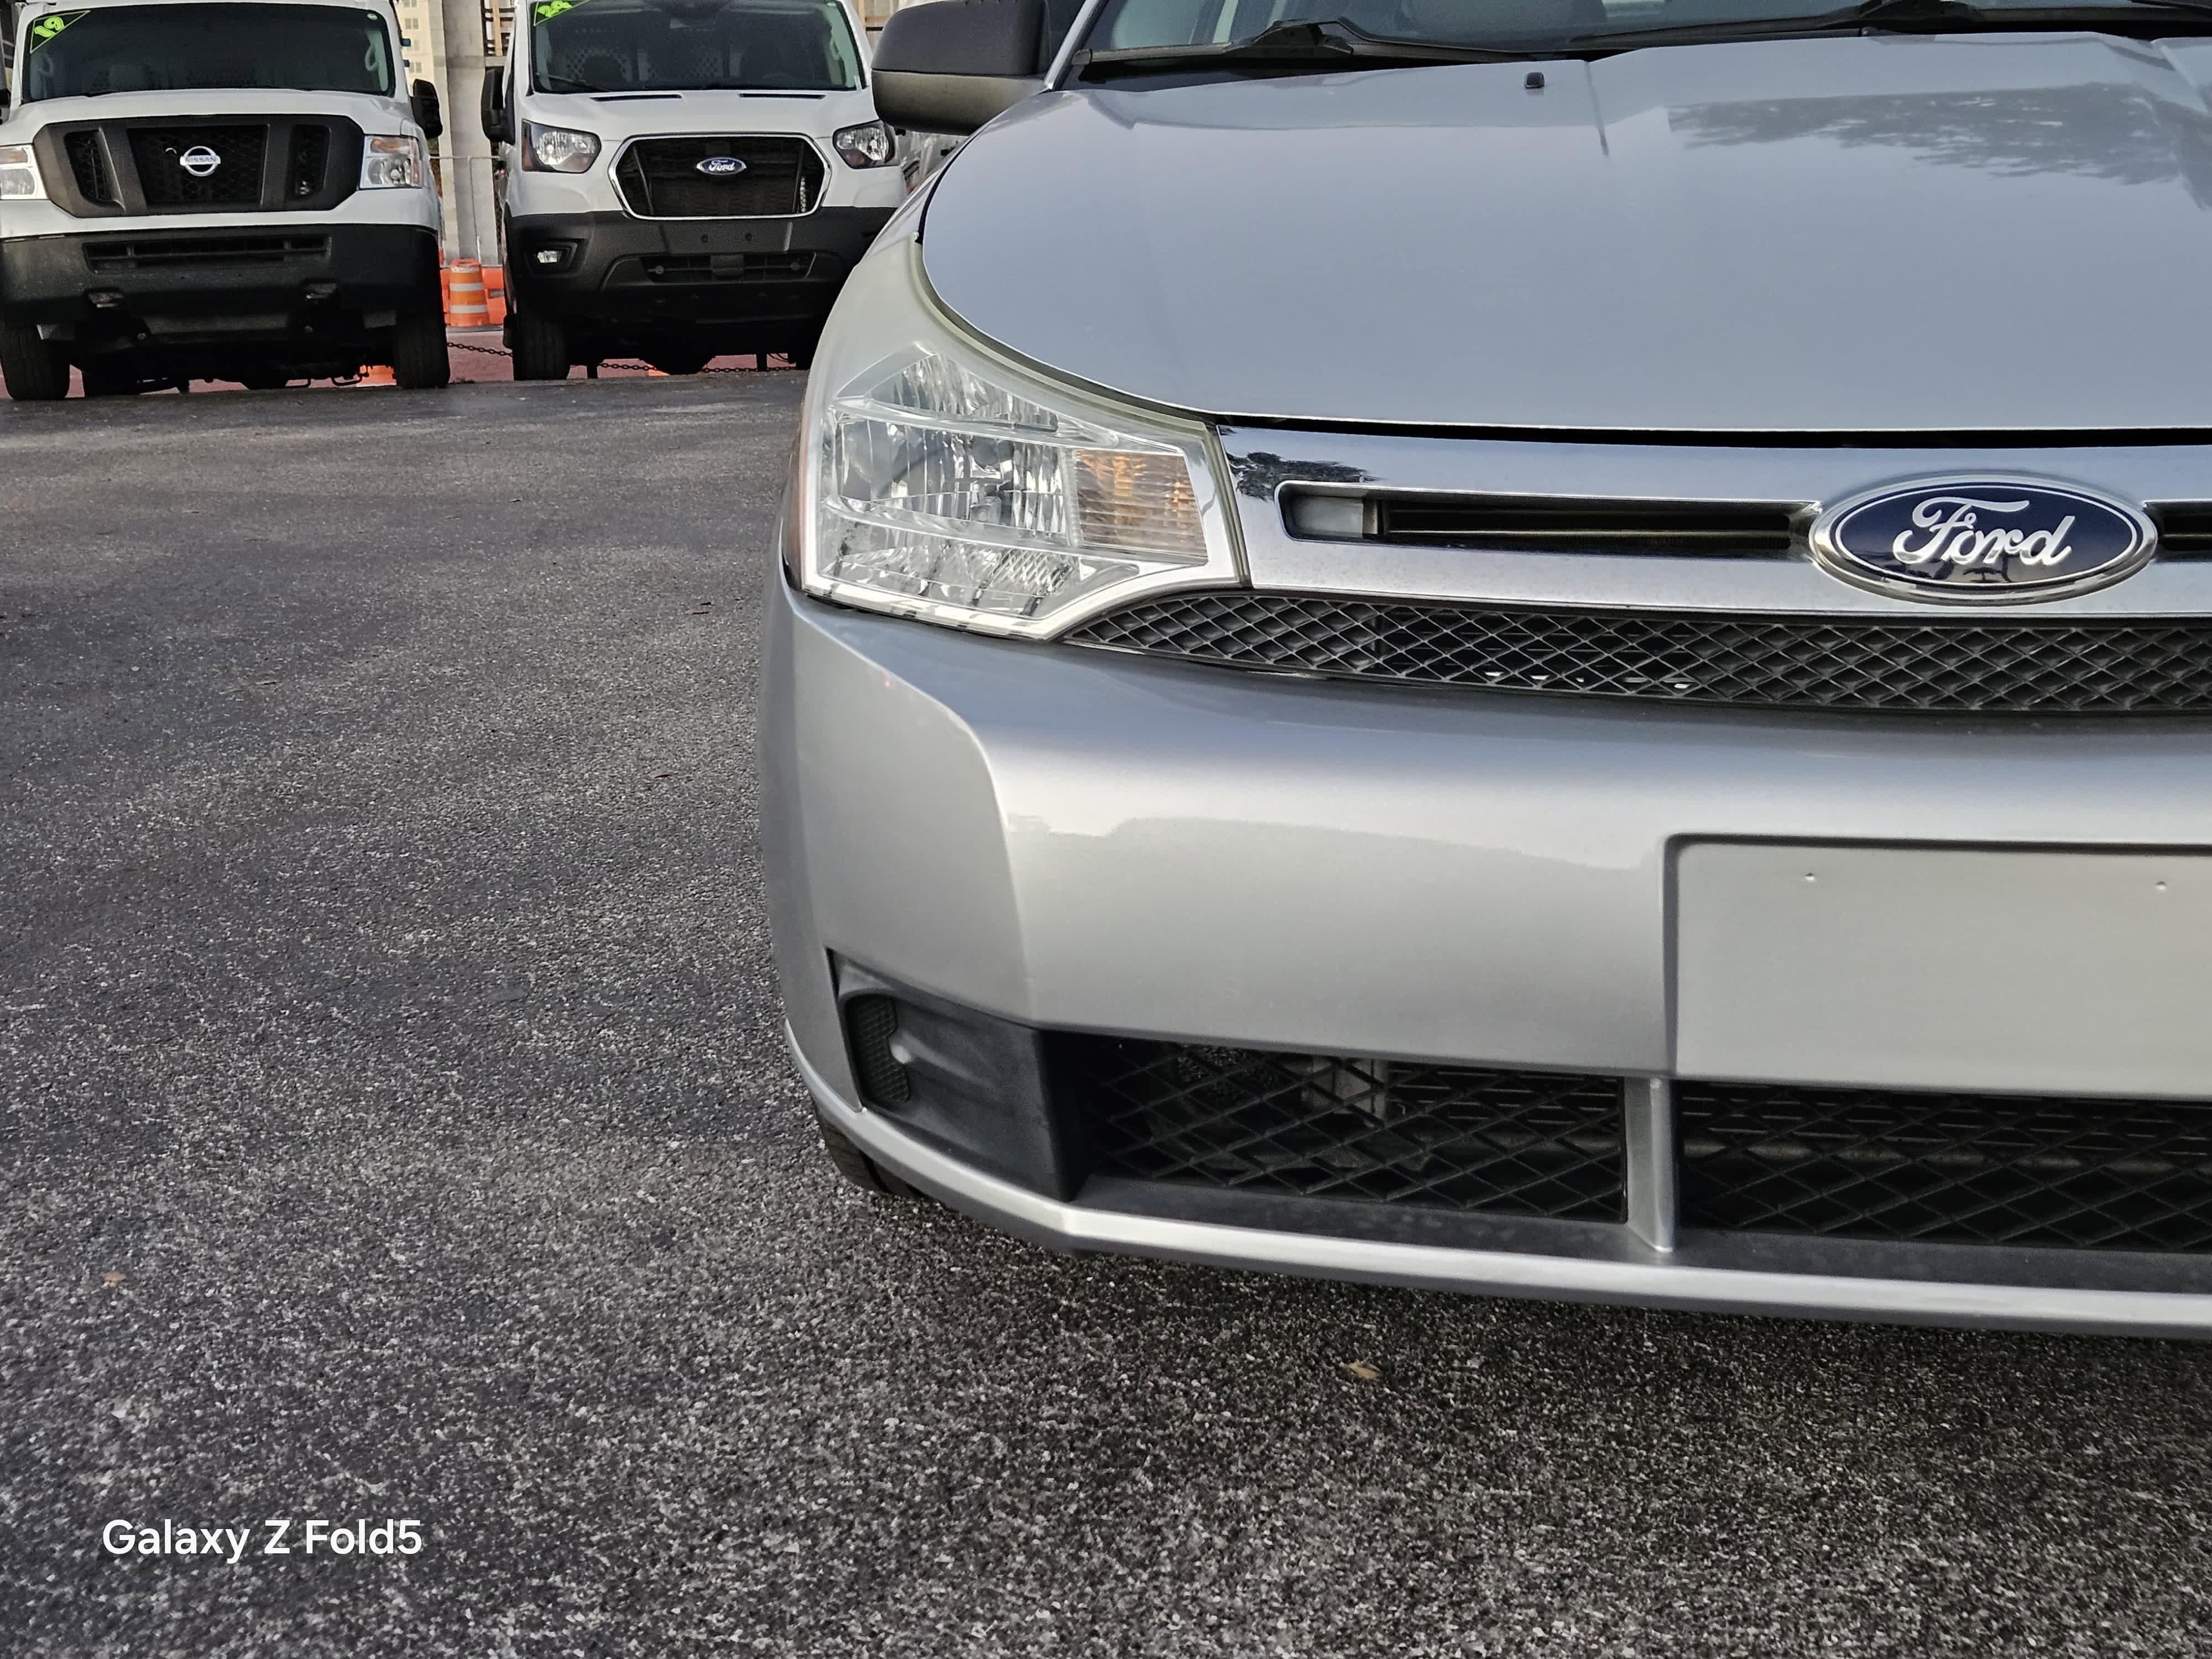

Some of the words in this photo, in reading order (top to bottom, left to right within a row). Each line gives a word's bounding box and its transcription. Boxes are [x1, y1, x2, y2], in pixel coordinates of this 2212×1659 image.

[34, 16, 65, 37] 19
[708, 160, 735, 171] Ford
[1893, 497, 2075, 565] Ford
